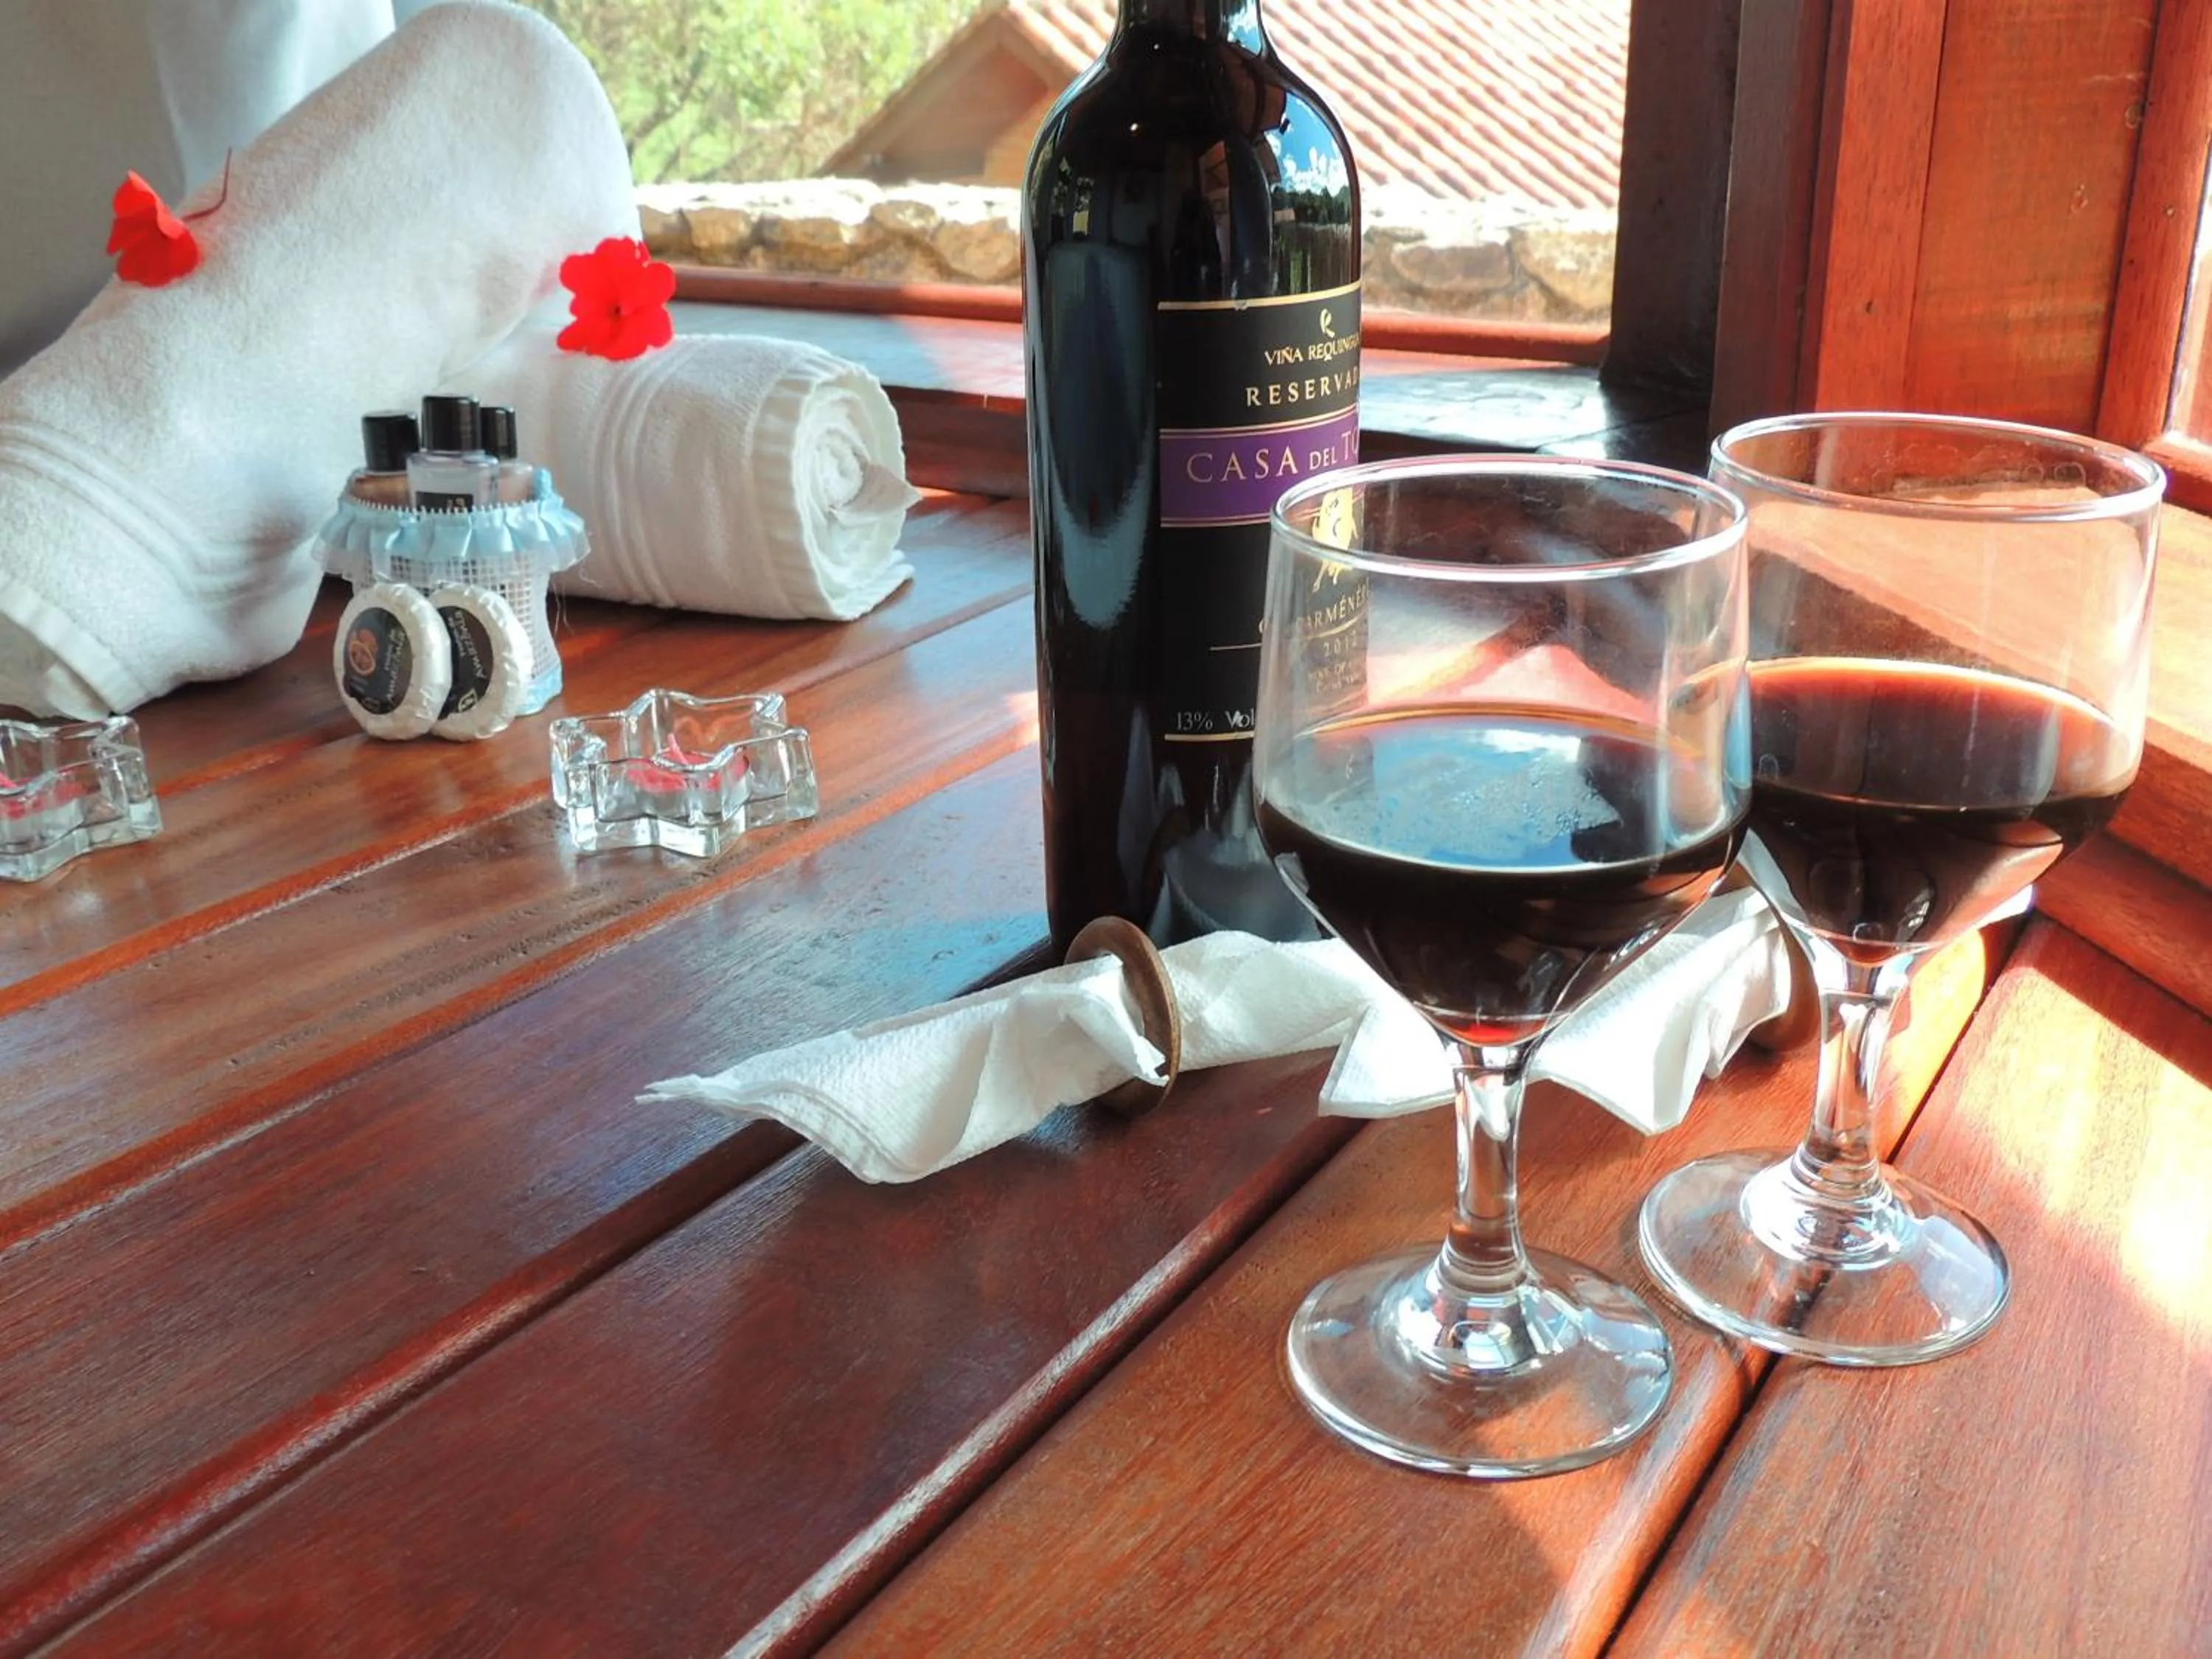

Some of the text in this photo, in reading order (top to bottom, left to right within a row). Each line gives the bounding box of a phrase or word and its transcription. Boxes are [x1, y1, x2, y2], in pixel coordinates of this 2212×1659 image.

[1264, 345, 1304, 366] VIÑA
[1245, 366, 1358, 407] RESERVAD
[1186, 427, 1358, 483] CASA DEL TO
[1178, 711, 1213, 731] 13%
